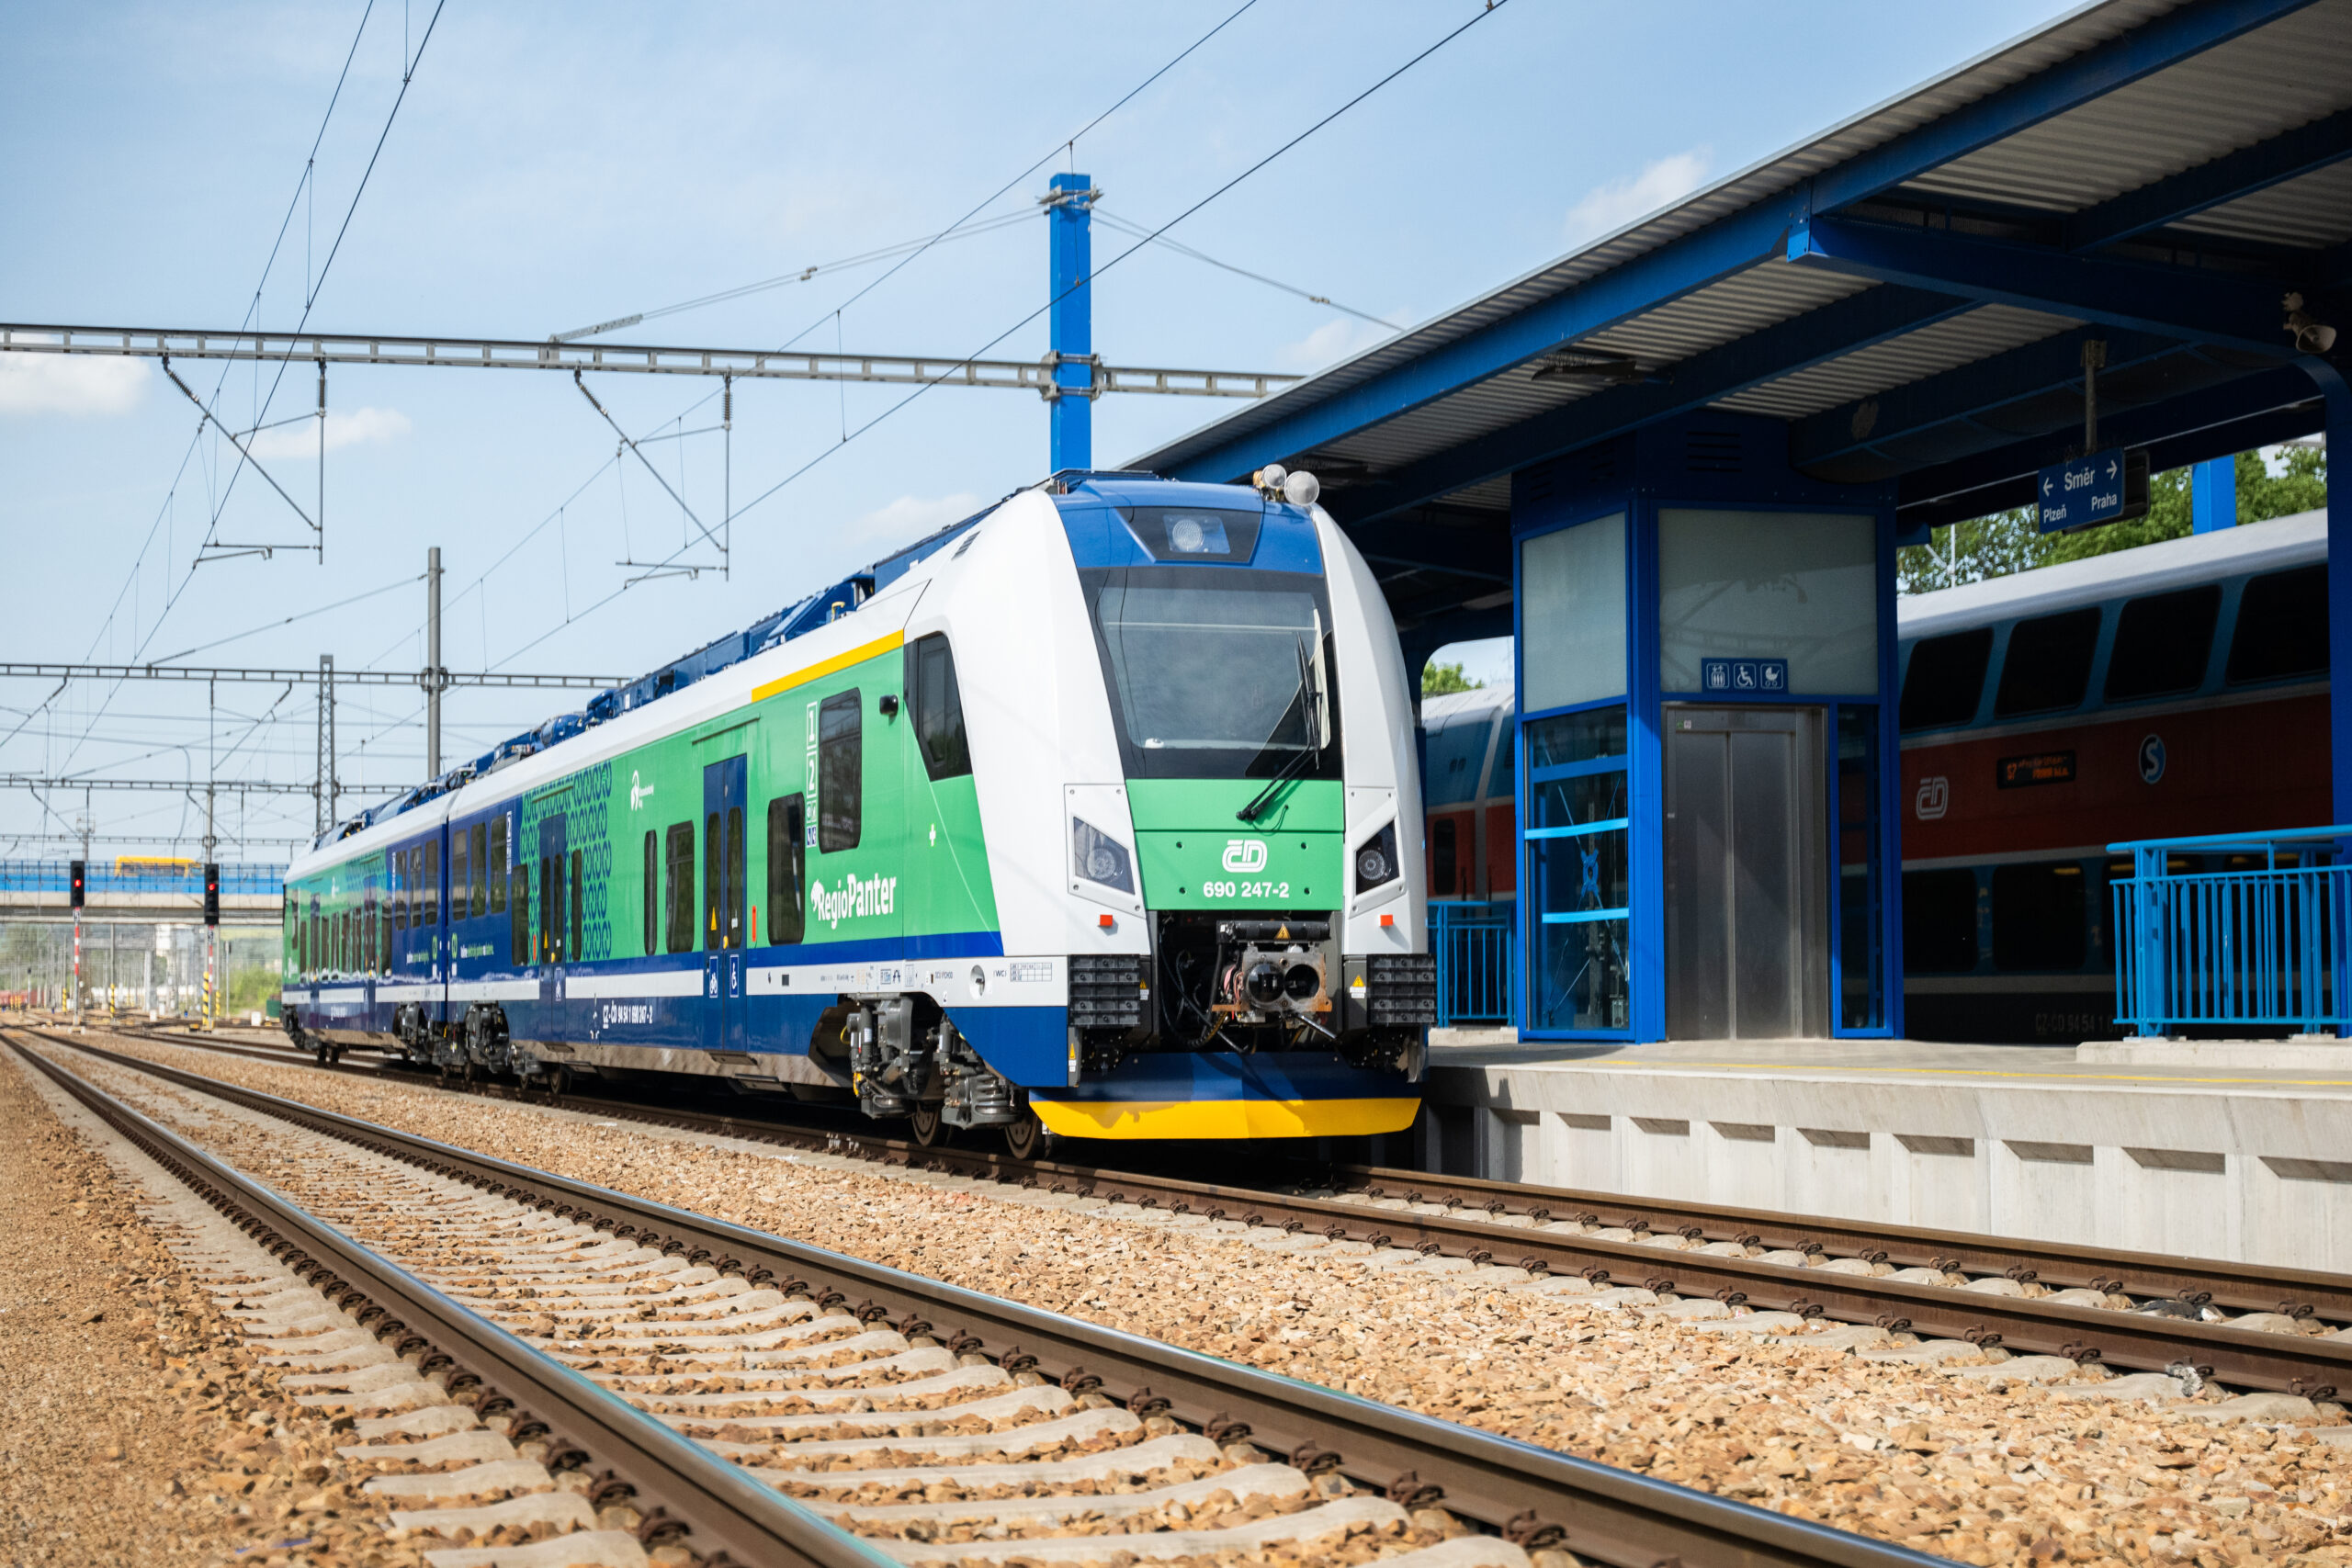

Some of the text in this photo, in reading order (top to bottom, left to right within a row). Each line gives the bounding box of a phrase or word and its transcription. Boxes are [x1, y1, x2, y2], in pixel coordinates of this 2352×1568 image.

[2064, 467, 2096, 491] Směr
[2043, 504, 2067, 524] Plzeň
[2091, 492, 2118, 512] Praha
[808, 710, 815, 742] 1
[808, 759, 815, 791] 2
[1222, 840, 1268, 873] ČD
[817, 873, 897, 931] RegioPanter
[1203, 881, 1290, 898] 690 247-2
